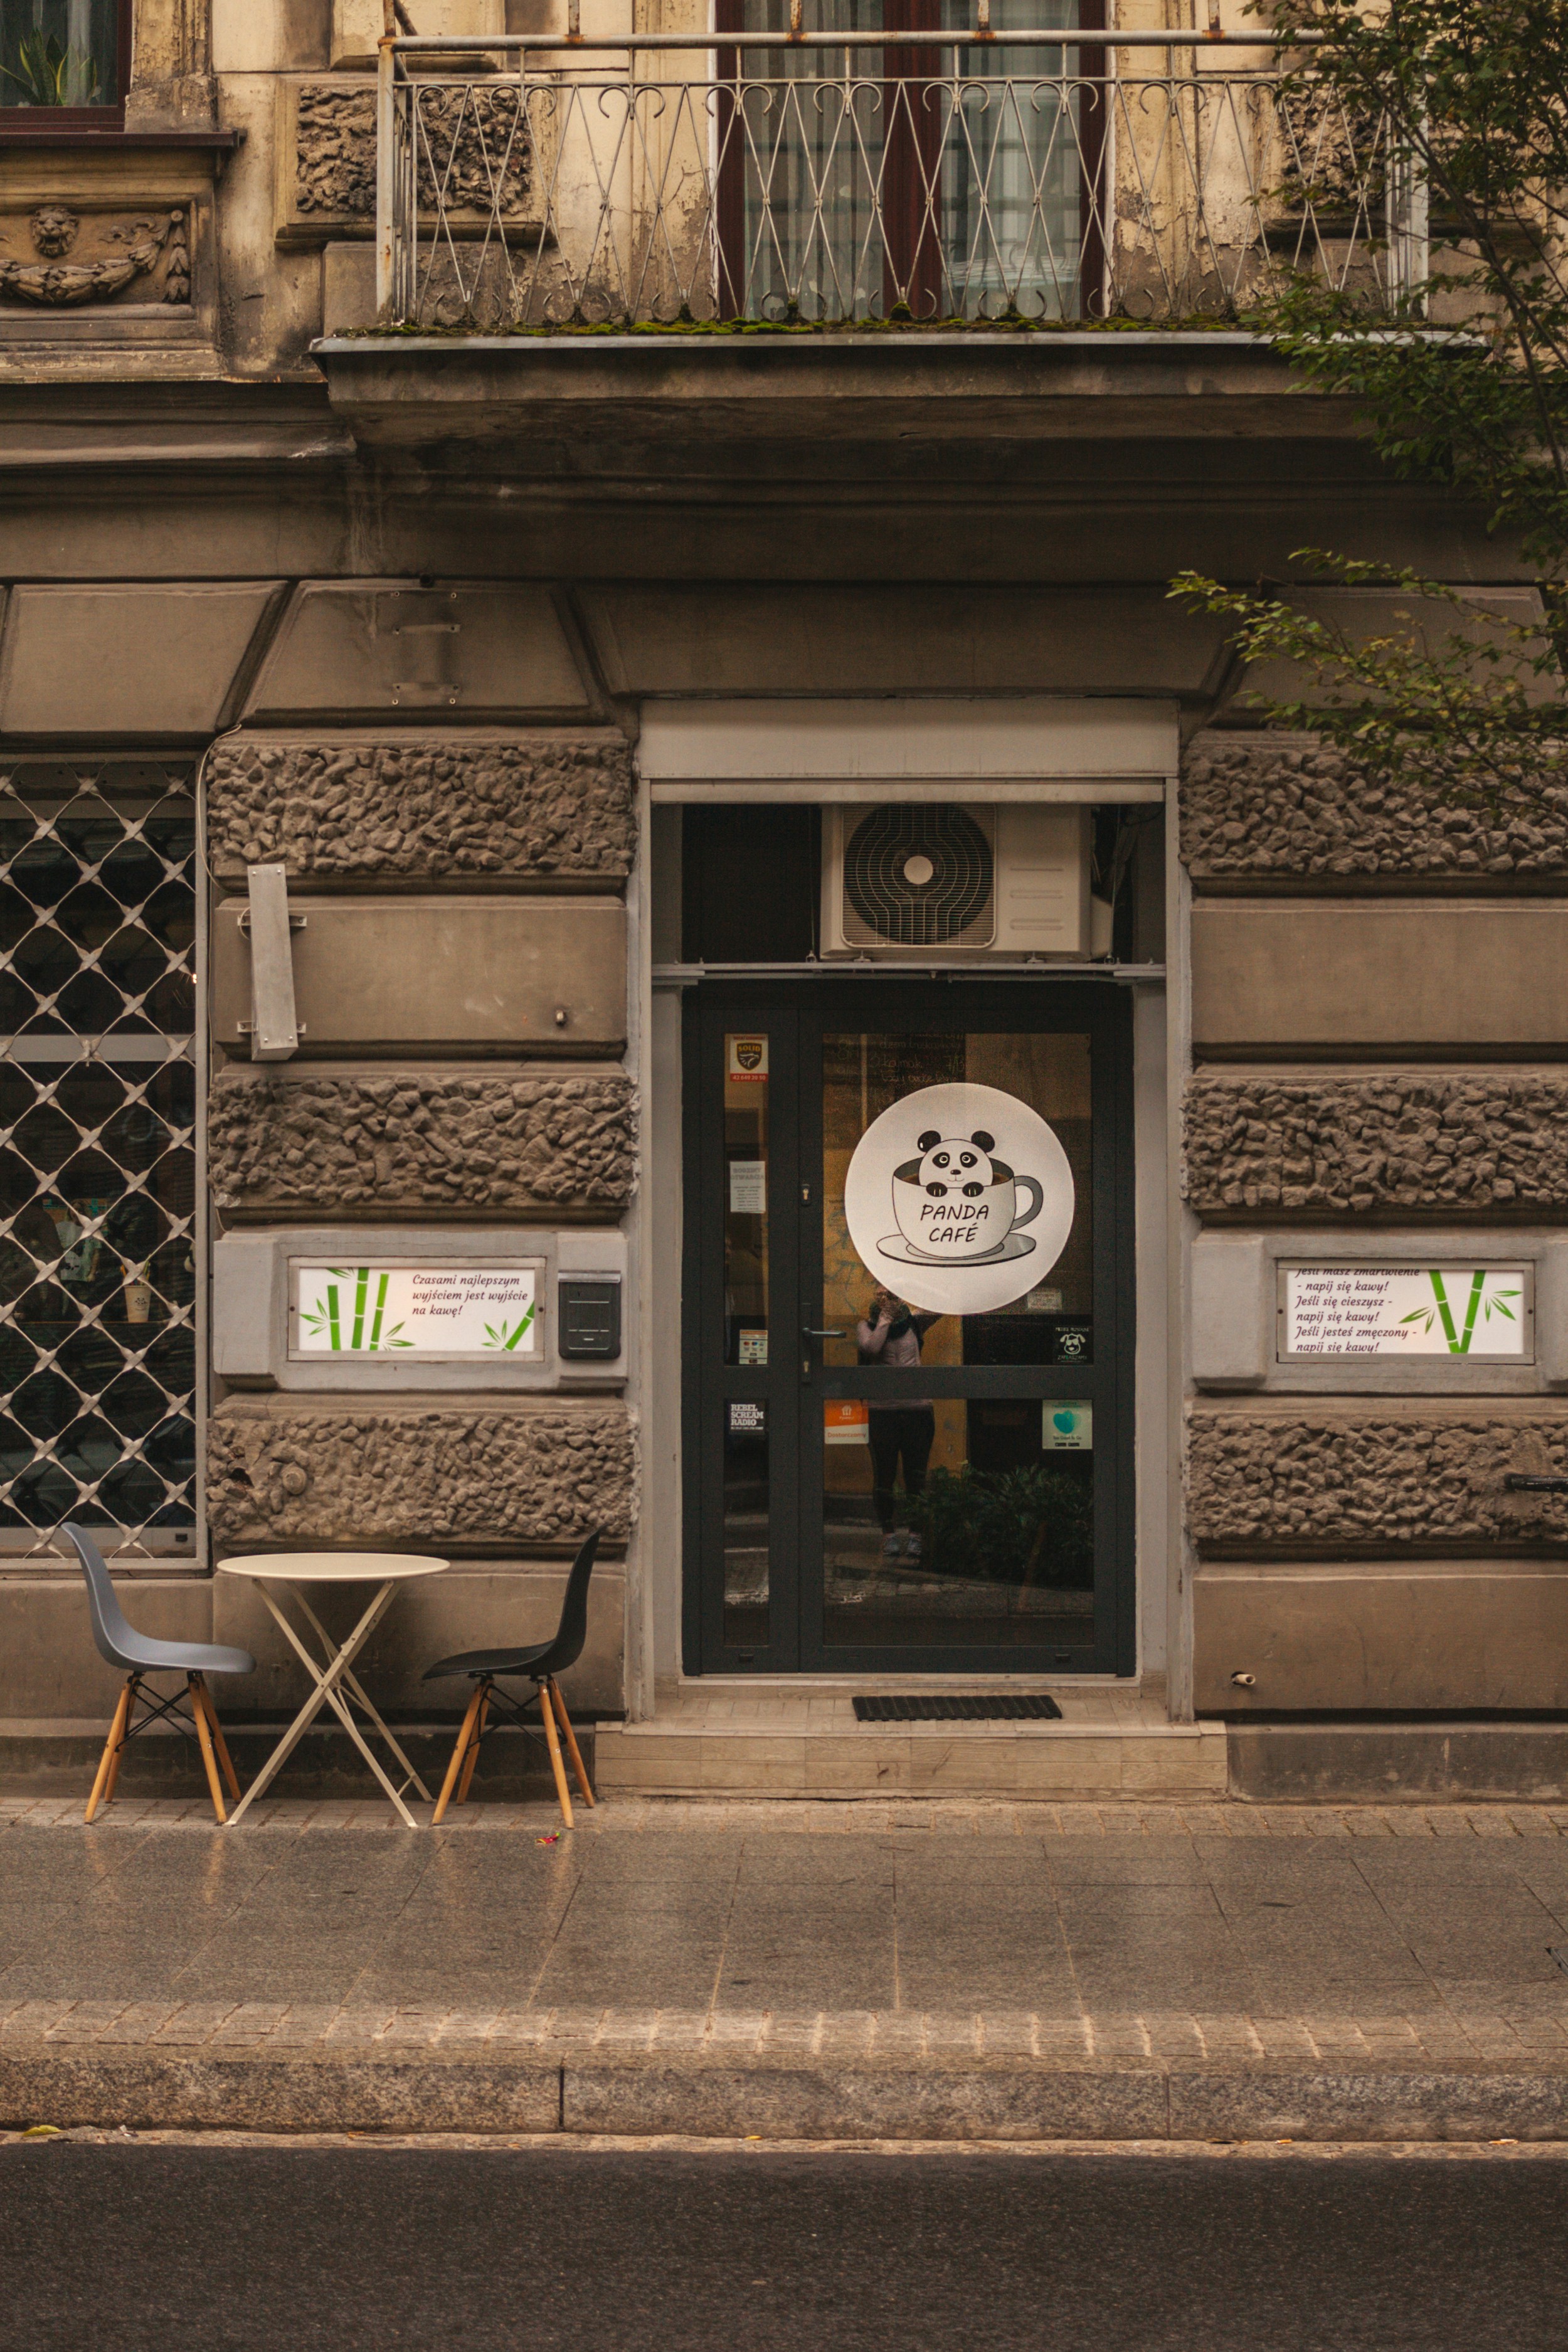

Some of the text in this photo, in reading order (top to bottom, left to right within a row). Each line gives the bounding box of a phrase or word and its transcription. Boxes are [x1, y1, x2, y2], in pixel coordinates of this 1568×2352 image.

[920, 1204, 989, 1221] PANDA
[929, 1222, 978, 1242] CAFÉ
[412, 1274, 520, 1288] Czasami najlepszym
[1305, 1281, 1333, 1294] napij
[1337, 1281, 1352, 1293] się
[1354, 1280, 1389, 1294] kawy!
[412, 1290, 528, 1303] wyjściem jest wyjście
[1294, 1295, 1320, 1309] Jeśli
[1322, 1296, 1337, 1309] się
[1341, 1296, 1385, 1310] cieszysz
[412, 1305, 463, 1318] na kawę!
[1296, 1311, 1380, 1325] napij się kawy!
[1294, 1326, 1320, 1340] Jeśli
[1321, 1326, 1353, 1340] jesteś
[1355, 1329, 1408, 1340] zmęczony
[1296, 1341, 1380, 1353] napij się kawy!
